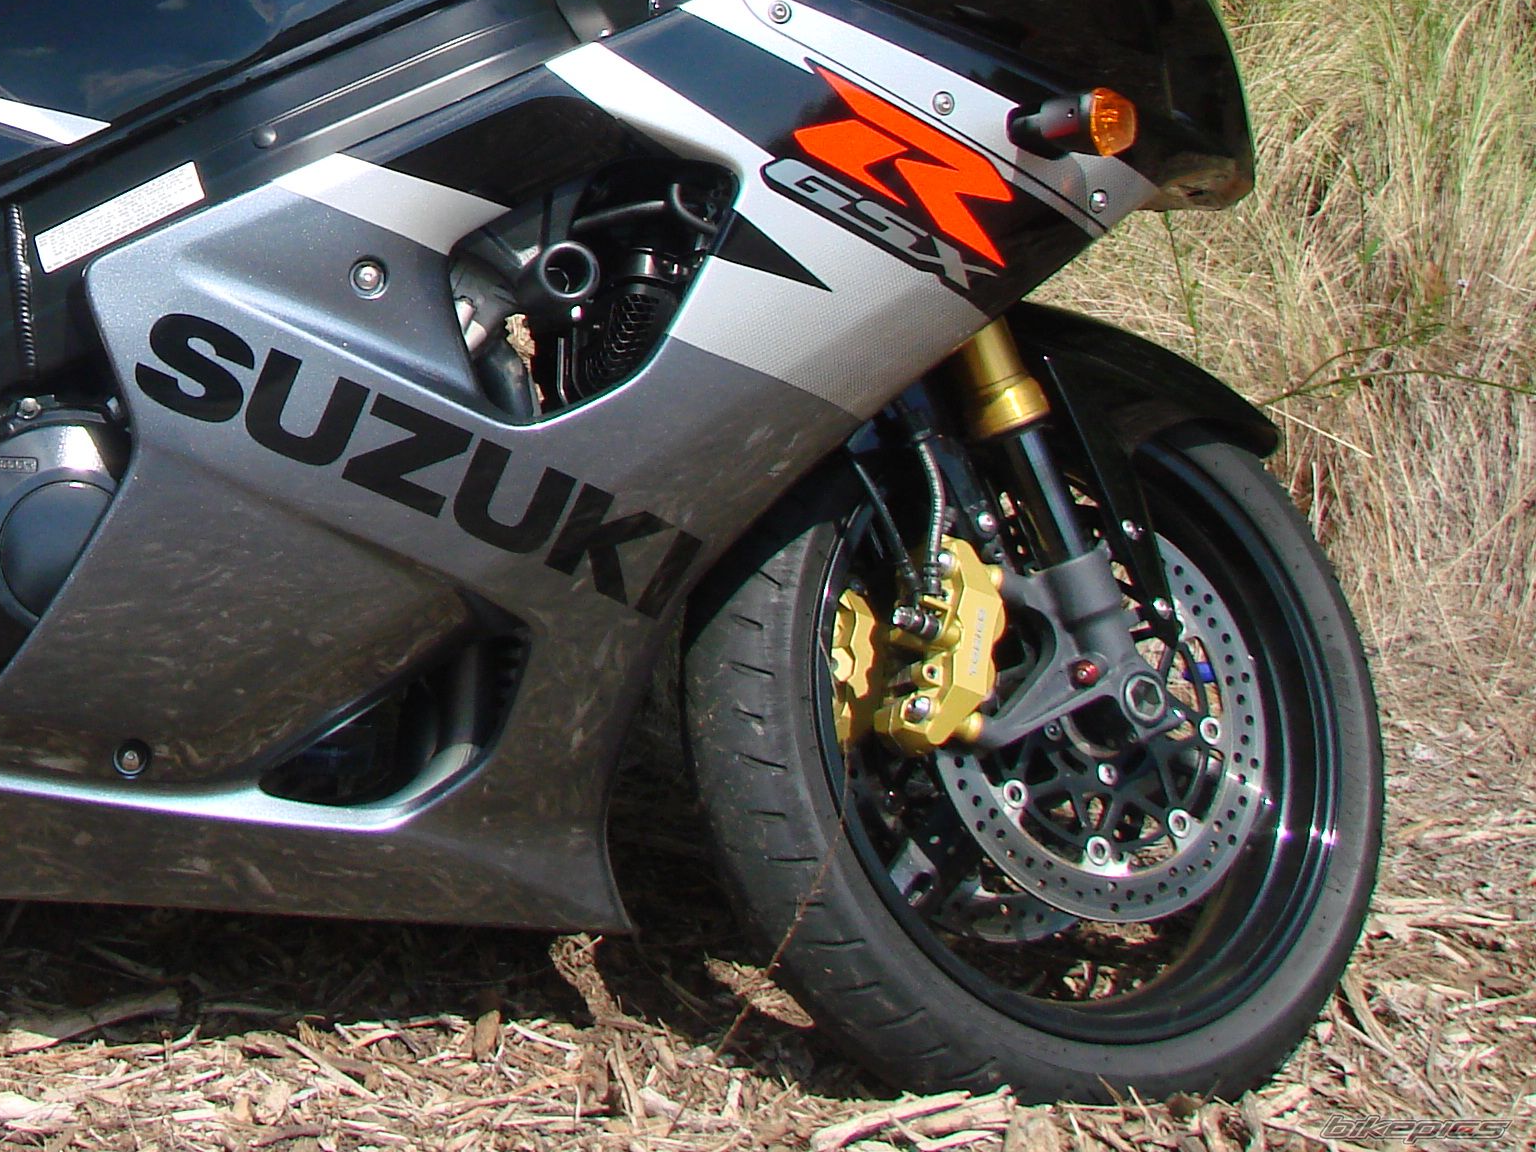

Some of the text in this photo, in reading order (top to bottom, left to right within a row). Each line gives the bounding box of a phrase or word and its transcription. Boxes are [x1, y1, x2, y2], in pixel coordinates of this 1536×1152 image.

[760, 158, 999, 291] GSX
[794, 59, 1014, 269] R
[136, 313, 703, 620] SUZUKI
